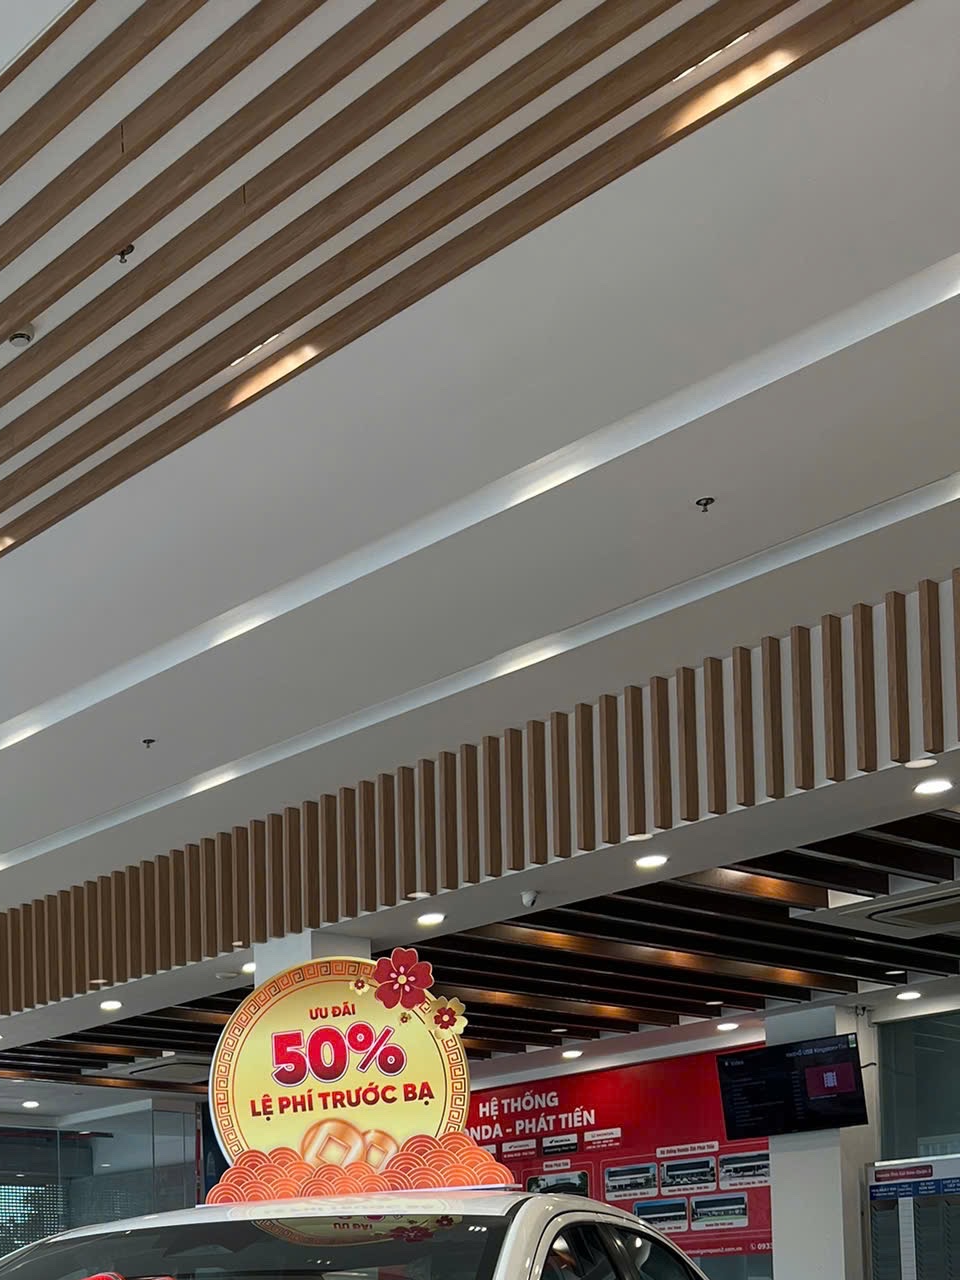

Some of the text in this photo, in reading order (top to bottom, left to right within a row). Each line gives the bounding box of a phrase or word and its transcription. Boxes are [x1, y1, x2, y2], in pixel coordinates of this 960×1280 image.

[309, 1001, 356, 1020] ƯU ĐÃI
[272, 1021, 407, 1087] 50%
[250, 1081, 435, 1121] LỆ PHÍ TRƯỚC BẠ
[479, 1090, 559, 1120] HỆ THỐNG
[515, 1111, 557, 1135] PHÁT
[559, 1106, 595, 1129] TIẾN
